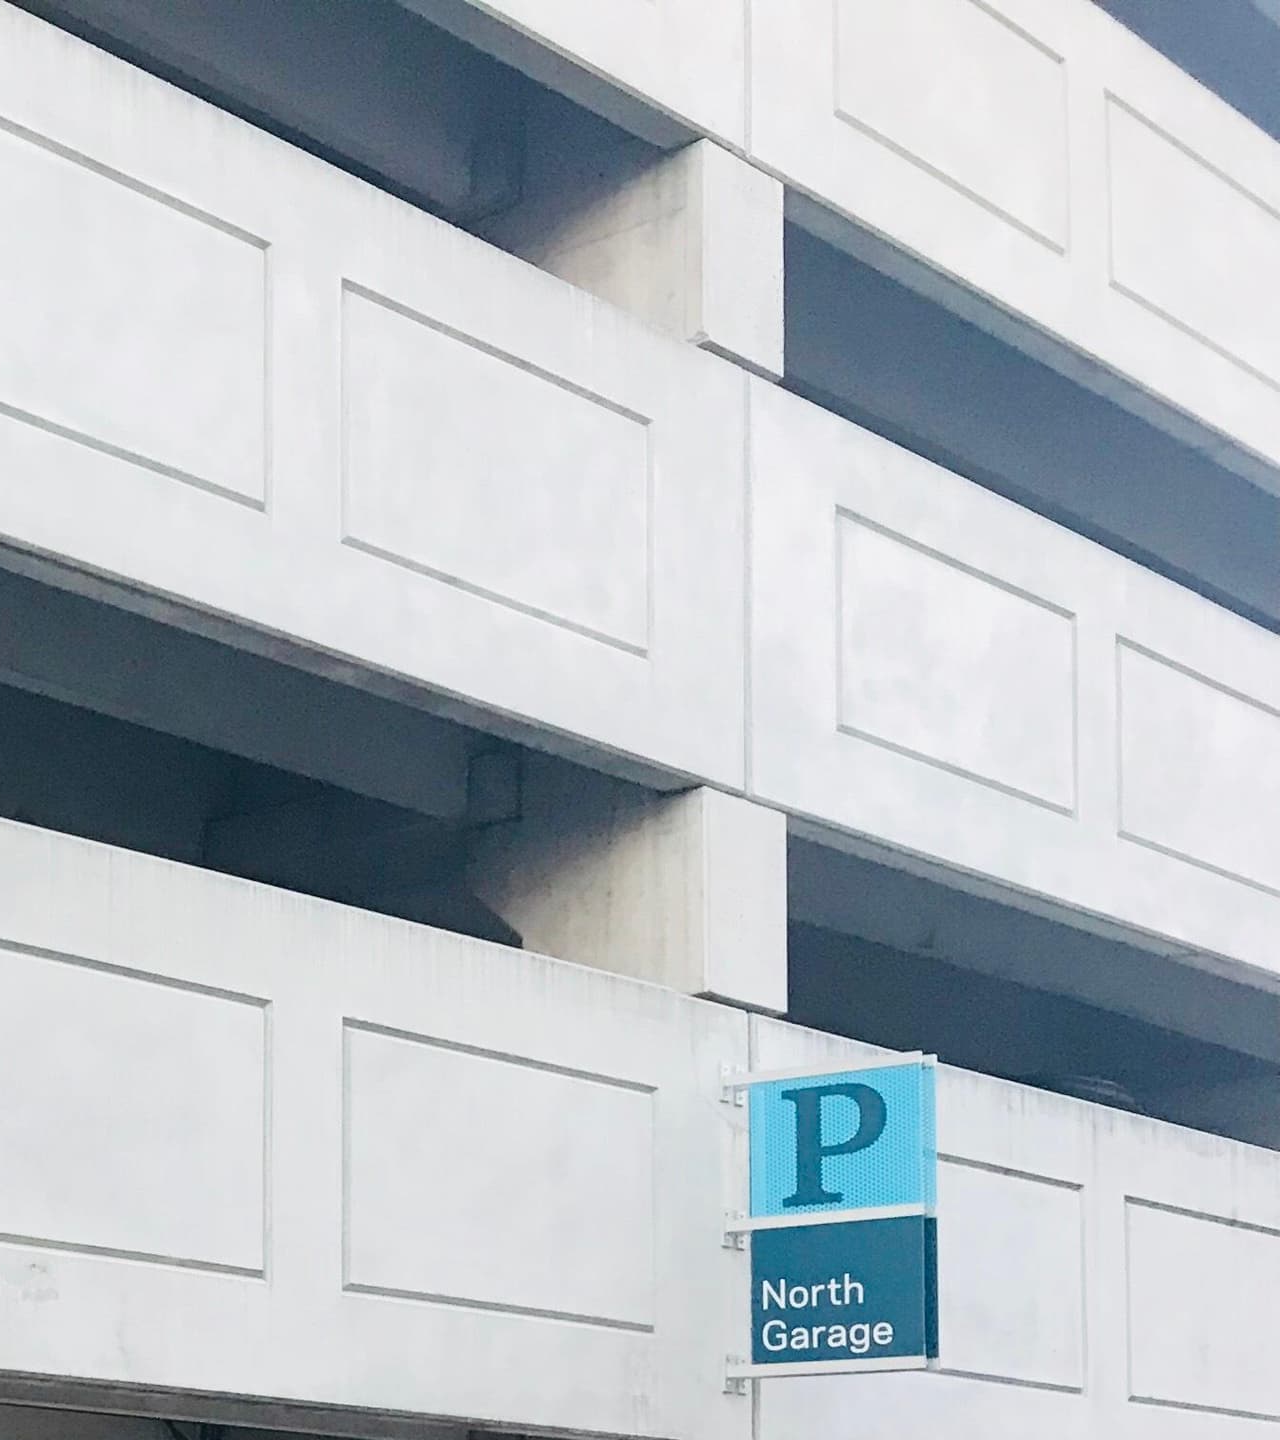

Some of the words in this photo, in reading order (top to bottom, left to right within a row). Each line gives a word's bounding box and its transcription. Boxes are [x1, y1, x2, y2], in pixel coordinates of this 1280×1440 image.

[781, 1083, 887, 1208] P
[761, 1273, 864, 1310] North
[761, 1319, 896, 1354] Garage
